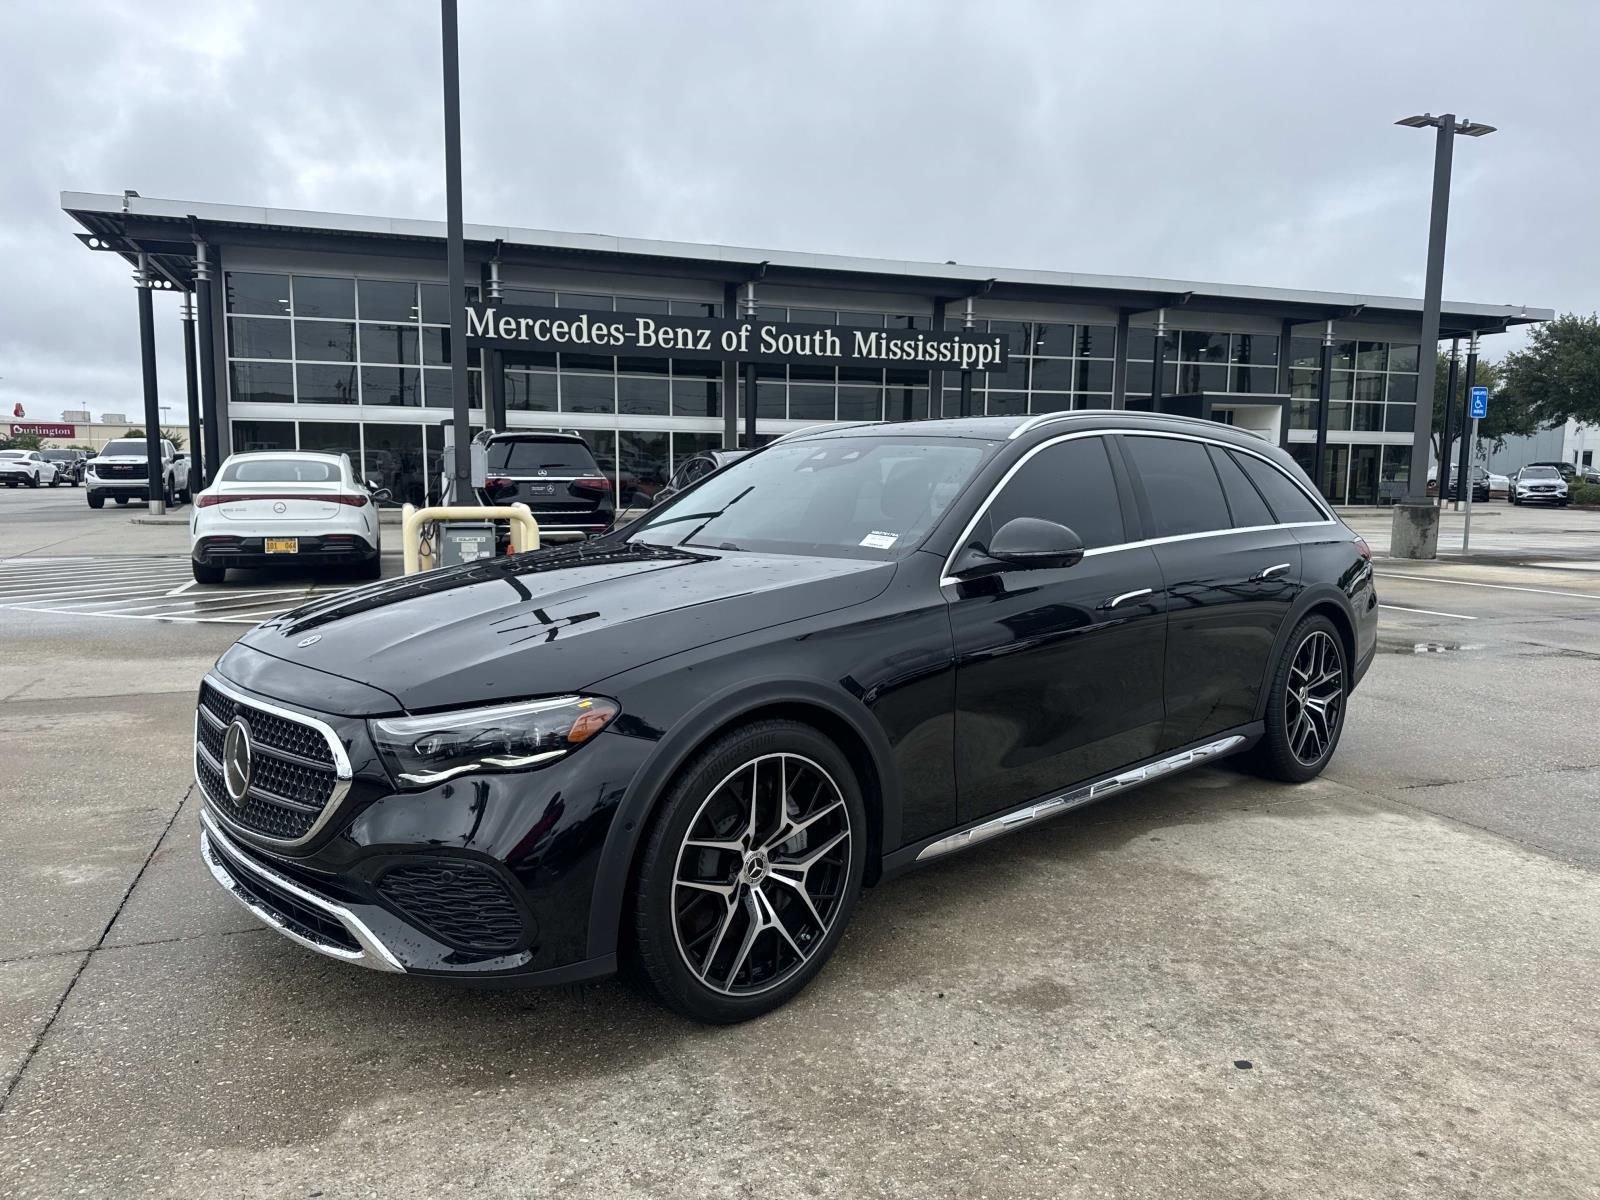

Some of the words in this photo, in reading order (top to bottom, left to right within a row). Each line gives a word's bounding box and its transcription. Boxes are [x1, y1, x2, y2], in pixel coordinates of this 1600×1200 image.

[465, 306, 712, 351] Mercedes-Benz
[721, 324, 752, 352] of
[760, 325, 843, 358] South
[852, 330, 1002, 370] Mississippi
